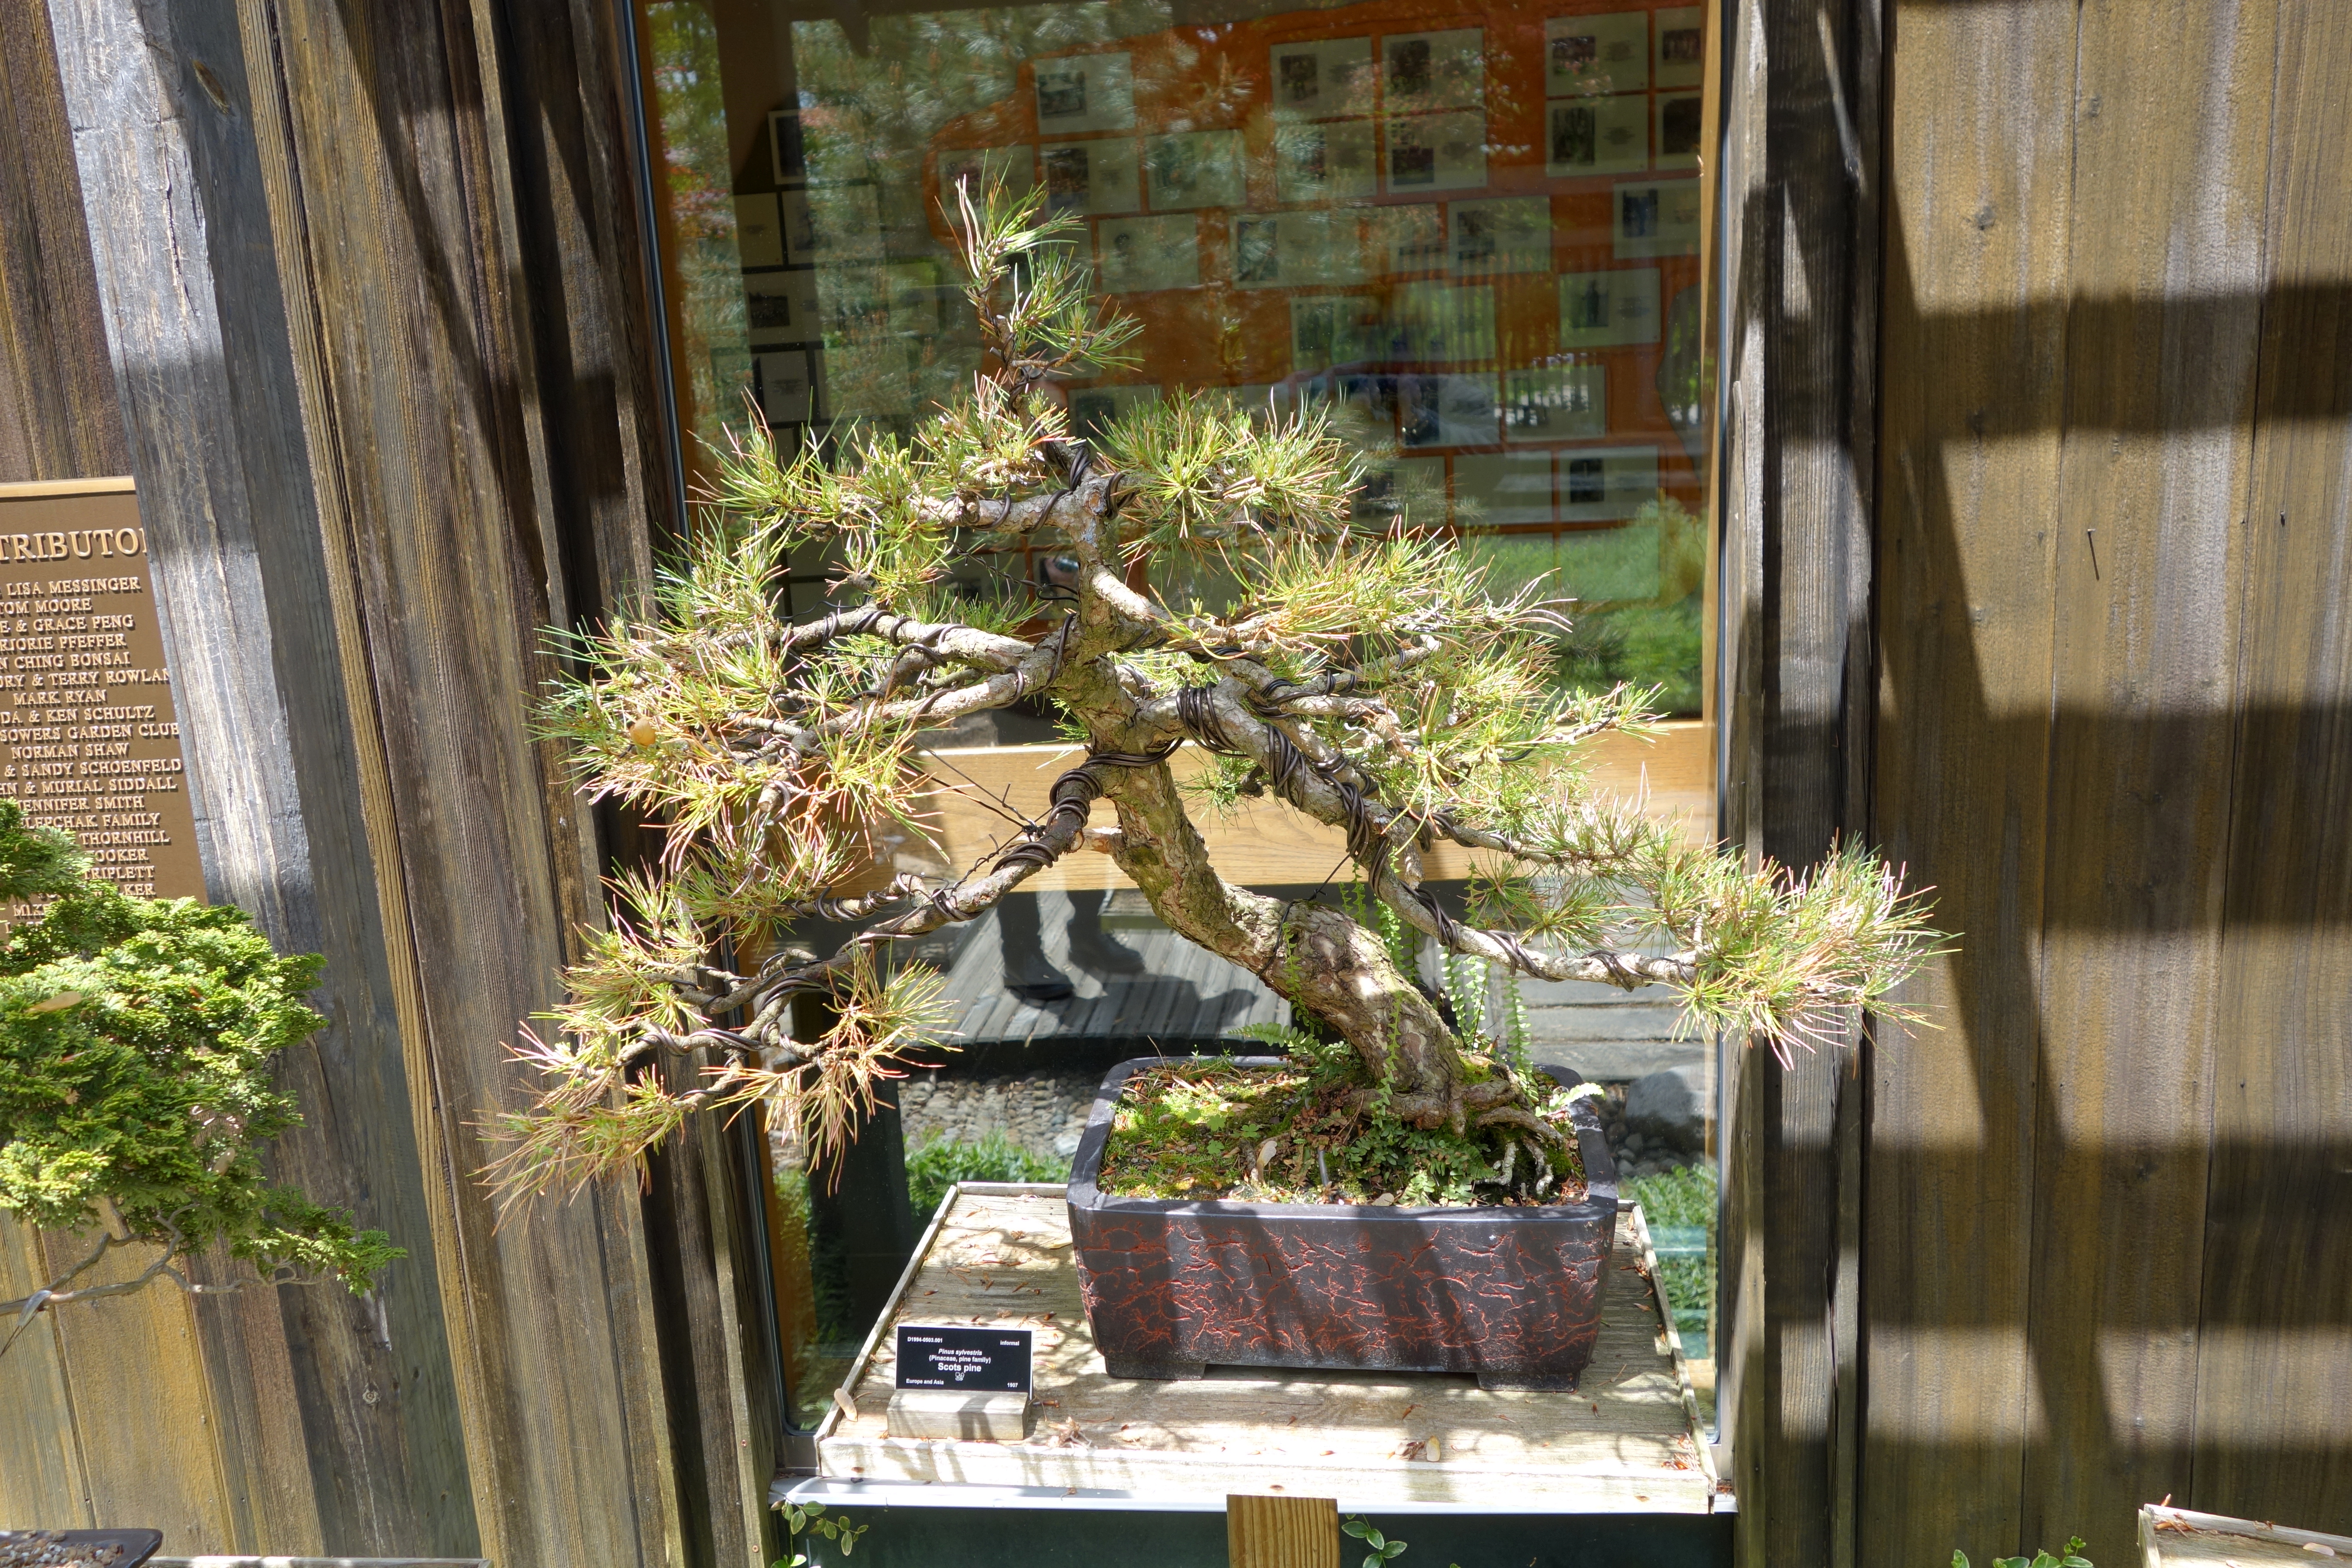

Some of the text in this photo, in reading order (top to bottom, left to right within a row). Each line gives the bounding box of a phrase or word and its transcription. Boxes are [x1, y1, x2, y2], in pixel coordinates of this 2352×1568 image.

[6, 577, 141, 595] LISA MESSINGER
[0, 598, 93, 615] TOM MOORE
[16, 619, 28, 632] &
[34, 617, 86, 632] GRACE
[91, 615, 134, 629] PENG
[0, 634, 127, 651] RJORIE PFEFFER
[15, 655, 64, 669] CHING
[70, 652, 130, 667] BONSAI
[32, 674, 43, 686] &
[48, 671, 99, 686] TERRY
[13, 689, 107, 705] MARK RYAN
[0, 705, 155, 724] DA & KEN SCHULTZ
[0, 723, 179, 742] SOWERS GARDEN CLUB
[11, 743, 129, 759] NORMAN SHAW
[5, 759, 181, 777] & SANDY SCHOENFELD
[24, 781, 36, 794] &
[41, 779, 104, 794] MURIAL
[109, 777, 178, 791] SIDDALL
[95, 796, 145, 809] SMITH
[102, 812, 160, 827] FAMILY
[79, 830, 171, 845] THORNHILL
[84, 866, 155, 880] TRIPLETT
[938, 1363, 962, 1371] Scots
